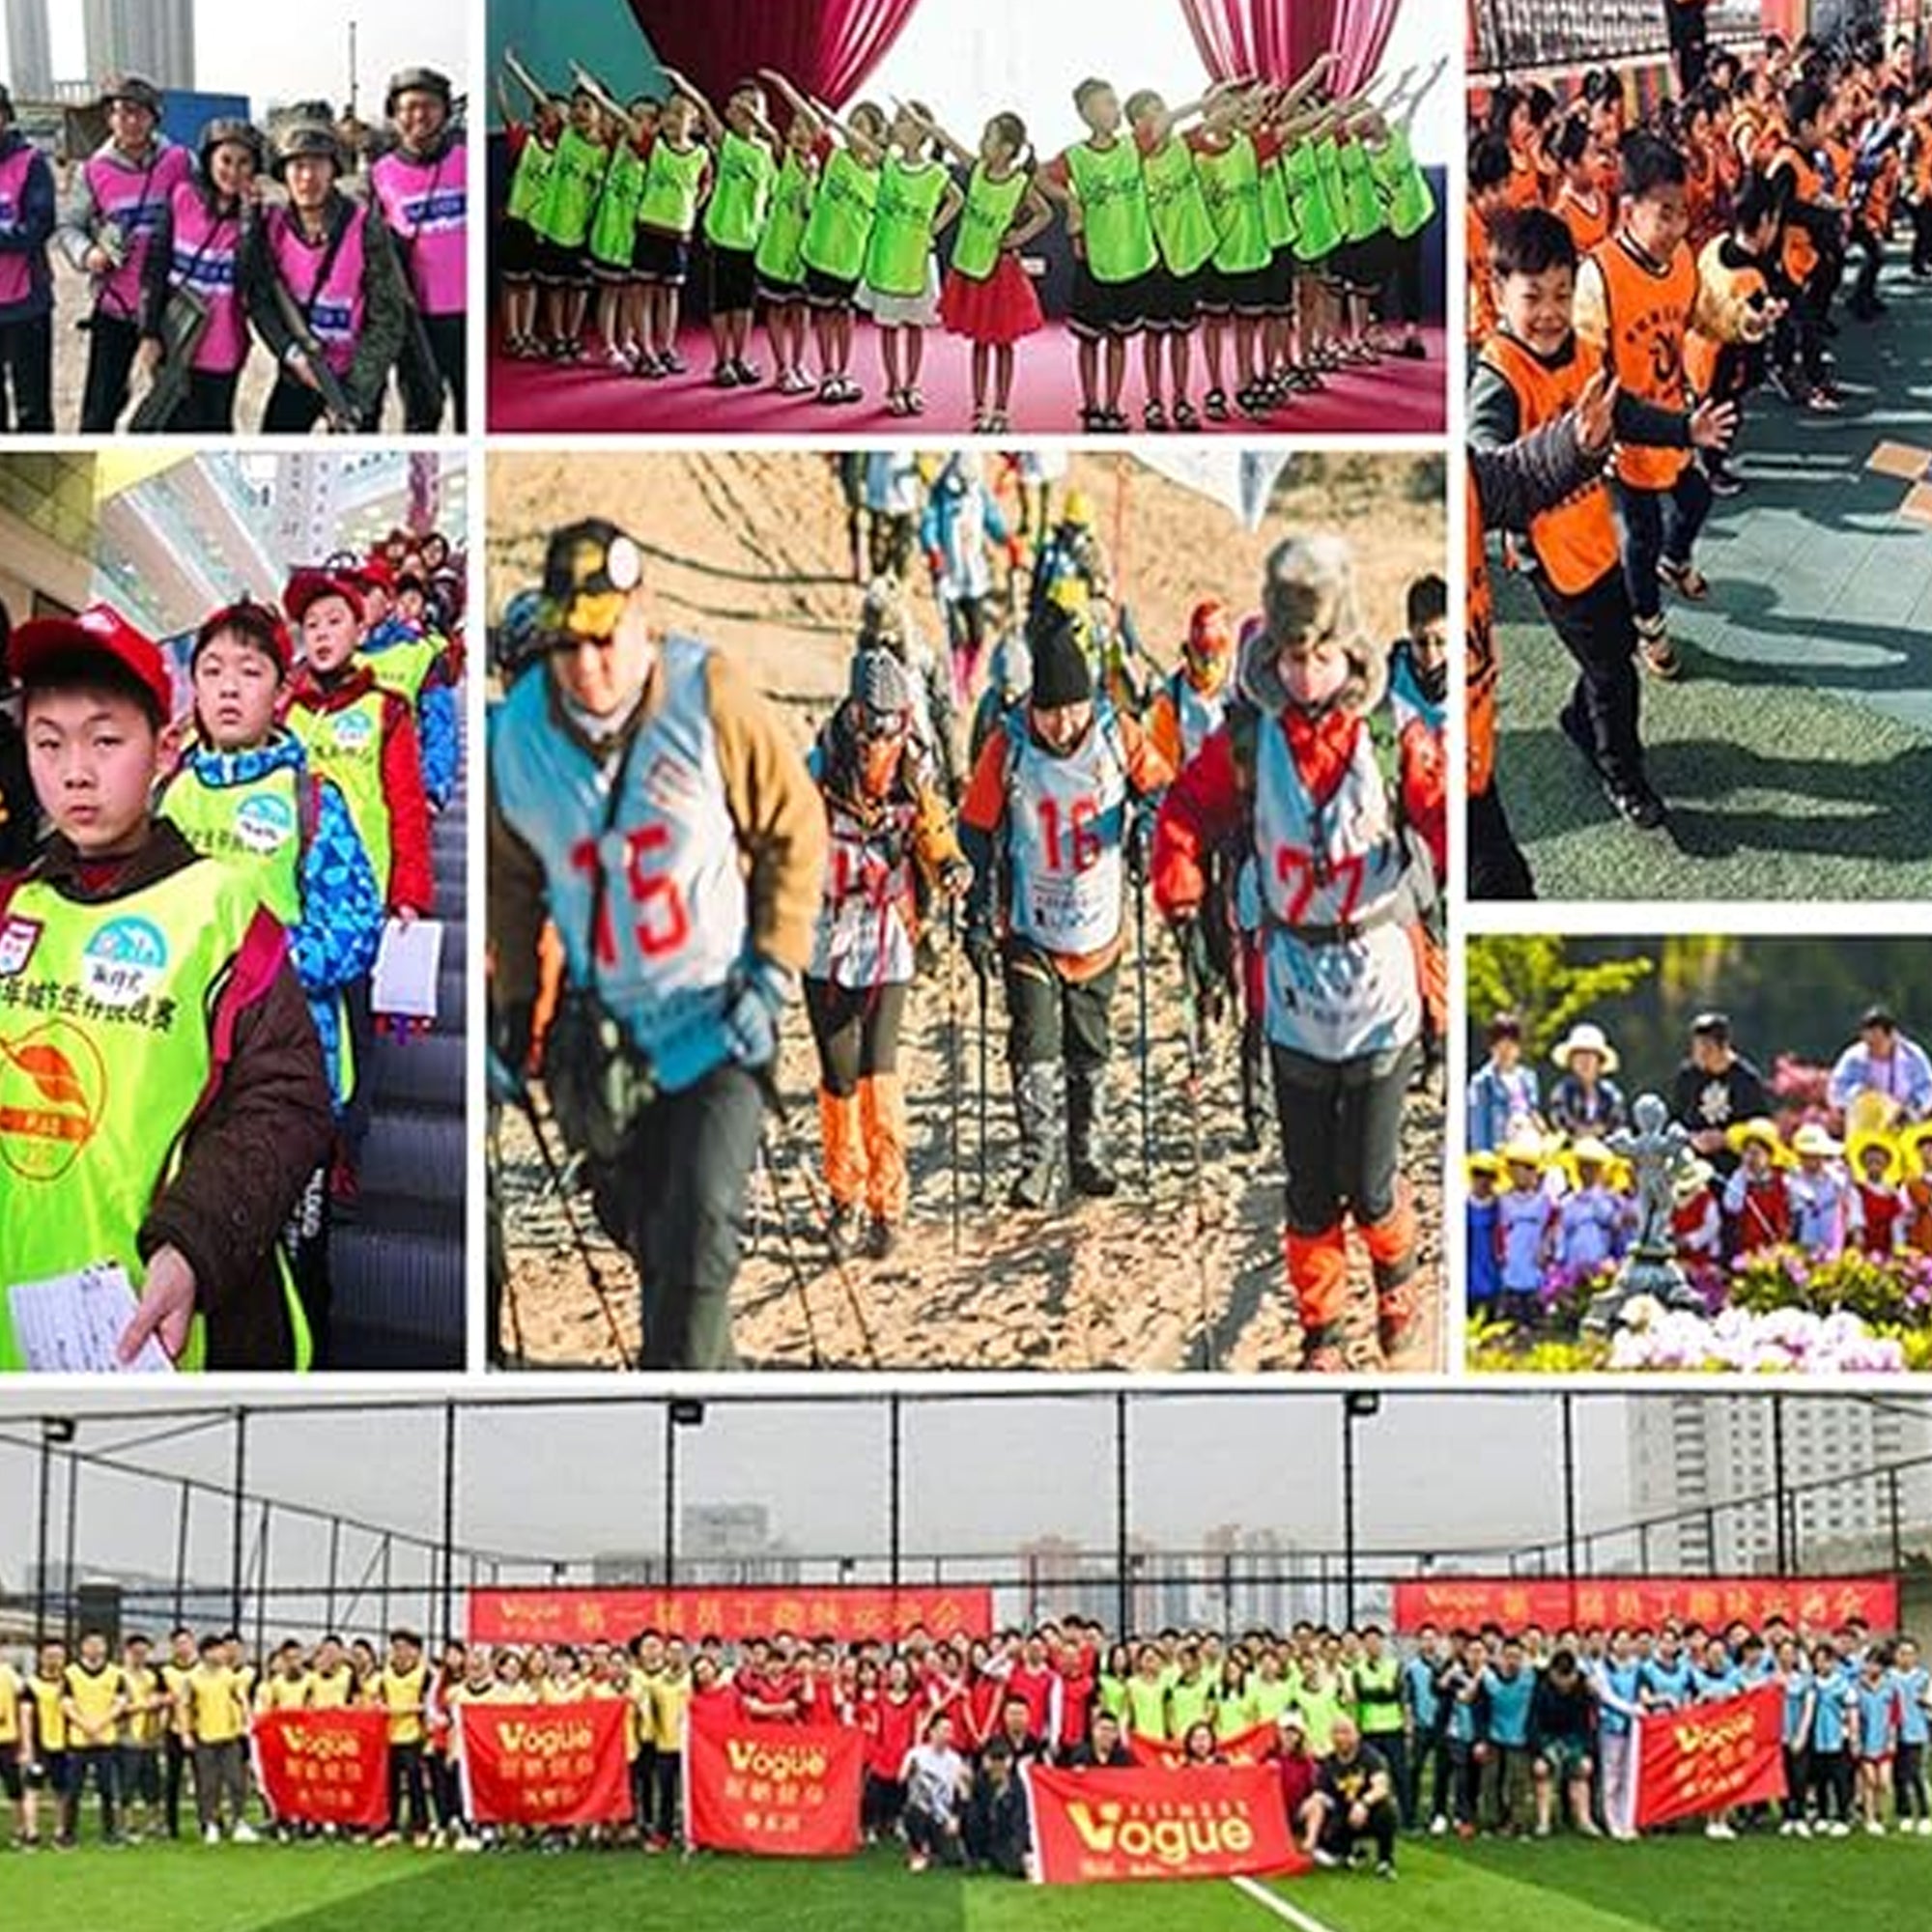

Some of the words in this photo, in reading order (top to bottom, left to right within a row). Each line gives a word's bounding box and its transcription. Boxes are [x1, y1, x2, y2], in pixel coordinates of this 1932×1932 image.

[1037, 796, 1100, 873] 16
[570, 823, 689, 964] 15
[497, 1721, 593, 1759] Vogue
[726, 1739, 826, 1781] Vogue
[1066, 1800, 1254, 1866] Vogue
